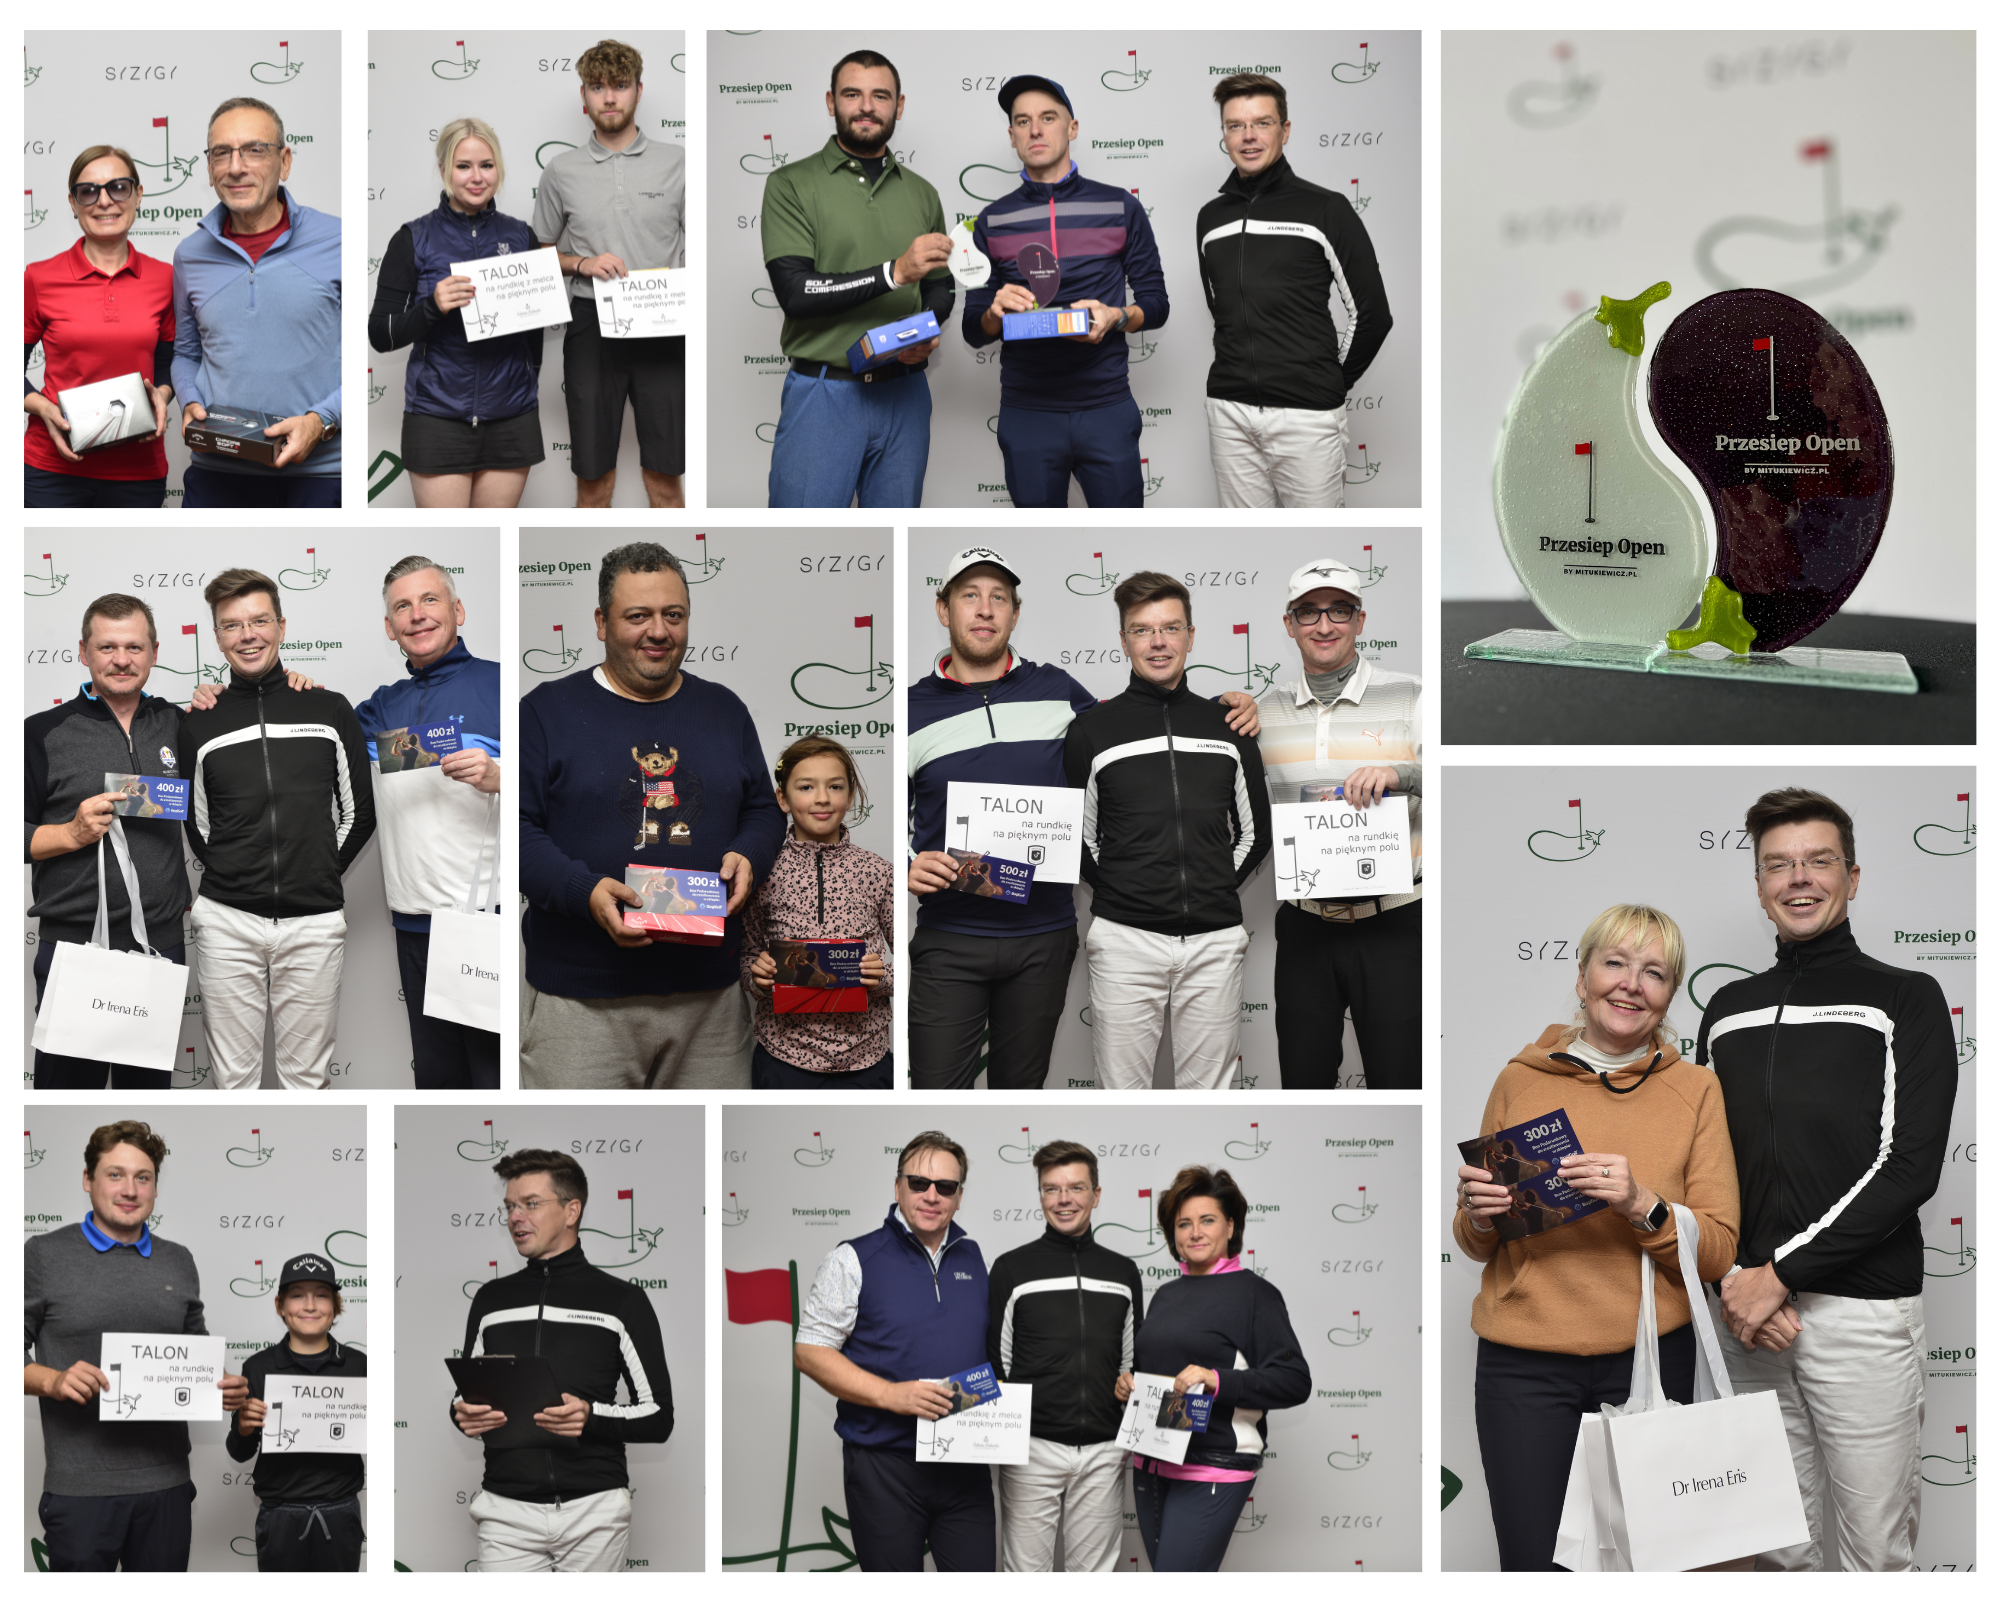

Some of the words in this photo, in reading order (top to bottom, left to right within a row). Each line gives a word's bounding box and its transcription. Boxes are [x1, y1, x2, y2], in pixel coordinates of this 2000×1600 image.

[105, 66, 178, 81] SYZYGY
[1209, 65, 1252, 76] Przesiep
[1254, 63, 1282, 74] Open
[719, 82, 764, 94] Przesiep
[765, 82, 792, 94] Open
[661, 119, 686, 128] Przes
[285, 133, 314, 145] Open
[1092, 138, 1136, 149] Przesiep
[1137, 137, 1164, 148] Open
[1319, 132, 1383, 147] SYZYGY
[163, 205, 203, 222] Open
[479, 262, 529, 282] TALON
[540, 283, 556, 294] polu
[618, 278, 668, 292] TALON
[804, 276, 876, 294] COMPRESSION
[744, 354, 786, 366] Przesiep
[1345, 396, 1384, 411] ZYGY
[1146, 407, 1172, 417] Open
[1716, 433, 1801, 455] Przesiep
[1803, 434, 1861, 454] Open
[1758, 466, 1830, 474] MITUKIEWICZ.PL
[165, 488, 184, 502] pen
[1539, 536, 1614, 558] Przesiep
[1618, 538, 1666, 556] Open
[962, 546, 1004, 562] Callaway
[519, 561, 556, 574] zesiep
[558, 560, 592, 573] Open
[800, 554, 886, 573] SYZYGY
[1185, 571, 1259, 587] SYZYGY
[1575, 568, 1638, 578] MITUKIEWICZ.PL
[133, 573, 206, 588] SYZYGY
[280, 640, 314, 651] zesiep
[315, 640, 342, 651] Open
[1369, 639, 1398, 651] Open
[684, 646, 739, 662] ZYGY
[427, 727, 446, 738] 400
[446, 726, 455, 736] zł
[784, 720, 863, 738] Przesiep
[866, 720, 894, 737] Ope
[156, 783, 174, 792] 400
[175, 785, 184, 793] zł
[980, 796, 1044, 815] TALON
[1022, 821, 1034, 829] na
[1036, 821, 1072, 832] rundkię
[1304, 812, 1368, 831] TALON
[993, 830, 1005, 838] na
[1008, 829, 1048, 842] pięknym
[1051, 832, 1072, 842] polu
[1348, 834, 1360, 842] na
[1364, 832, 1399, 842] rundkię
[1699, 830, 1752, 850] SYZ
[1321, 846, 1332, 855] na
[1336, 845, 1376, 857] pięknym
[1379, 843, 1400, 854] polu
[1000, 864, 1018, 876] 500
[1018, 870, 1028, 878] zł
[688, 876, 708, 886] 300
[709, 878, 720, 888] zł
[1894, 929, 1961, 946] Przesiep
[828, 950, 849, 958] 300
[850, 949, 860, 958] zł
[461, 964, 473, 976] Dr
[476, 966, 500, 982] Irena
[92, 998, 106, 1010] Dr
[107, 1000, 131, 1015] Irena
[132, 1005, 149, 1018] Eris
[1241, 1002, 1268, 1013] Open
[1812, 1010, 1866, 1018] J.LINDEBERG
[1068, 1078, 1095, 1088] Przes
[1523, 1124, 1550, 1142] 300
[1550, 1118, 1563, 1134] zł
[571, 1138, 643, 1154] SYZYGY
[1325, 1138, 1366, 1149] Przesiep
[1368, 1138, 1394, 1148] Open
[1098, 1144, 1160, 1157] SYZYGY
[1544, 1176, 1570, 1191] 300
[792, 1207, 828, 1218] Przesiep
[828, 1208, 850, 1217] Open
[1256, 1203, 1280, 1213] Open
[38, 1213, 62, 1224] Open
[993, 1208, 1044, 1222] SYZYG
[220, 1215, 285, 1229] SYZYGY
[292, 1257, 328, 1272] Callaway
[1321, 1260, 1384, 1274] SYZYGY
[1146, 1266, 1182, 1279] Open
[334, 1276, 368, 1289] zesie
[628, 1277, 668, 1289] Open
[226, 1340, 262, 1350] rzesiep
[131, 1344, 189, 1360] TALON
[1926, 1346, 1963, 1364] esiep
[182, 1364, 214, 1375] rundkię
[966, 1372, 982, 1383] 400
[982, 1368, 990, 1378] zł
[157, 1374, 193, 1384] pięknym
[196, 1375, 214, 1384] polu
[291, 1385, 344, 1400] TALON
[1146, 1385, 1163, 1400] TAL
[1317, 1389, 1356, 1400] Przesiep
[1358, 1390, 1382, 1399] Open
[338, 1402, 368, 1412] rundkię
[1192, 1398, 1203, 1408] 400
[314, 1411, 346, 1420] pięknym
[350, 1411, 366, 1420] polu
[1004, 1421, 1022, 1430] polu
[1672, 1479, 1690, 1497] Dr
[1693, 1473, 1725, 1494] Irena
[1726, 1468, 1748, 1486] Eris
[1320, 1516, 1383, 1528] SYZYGY
